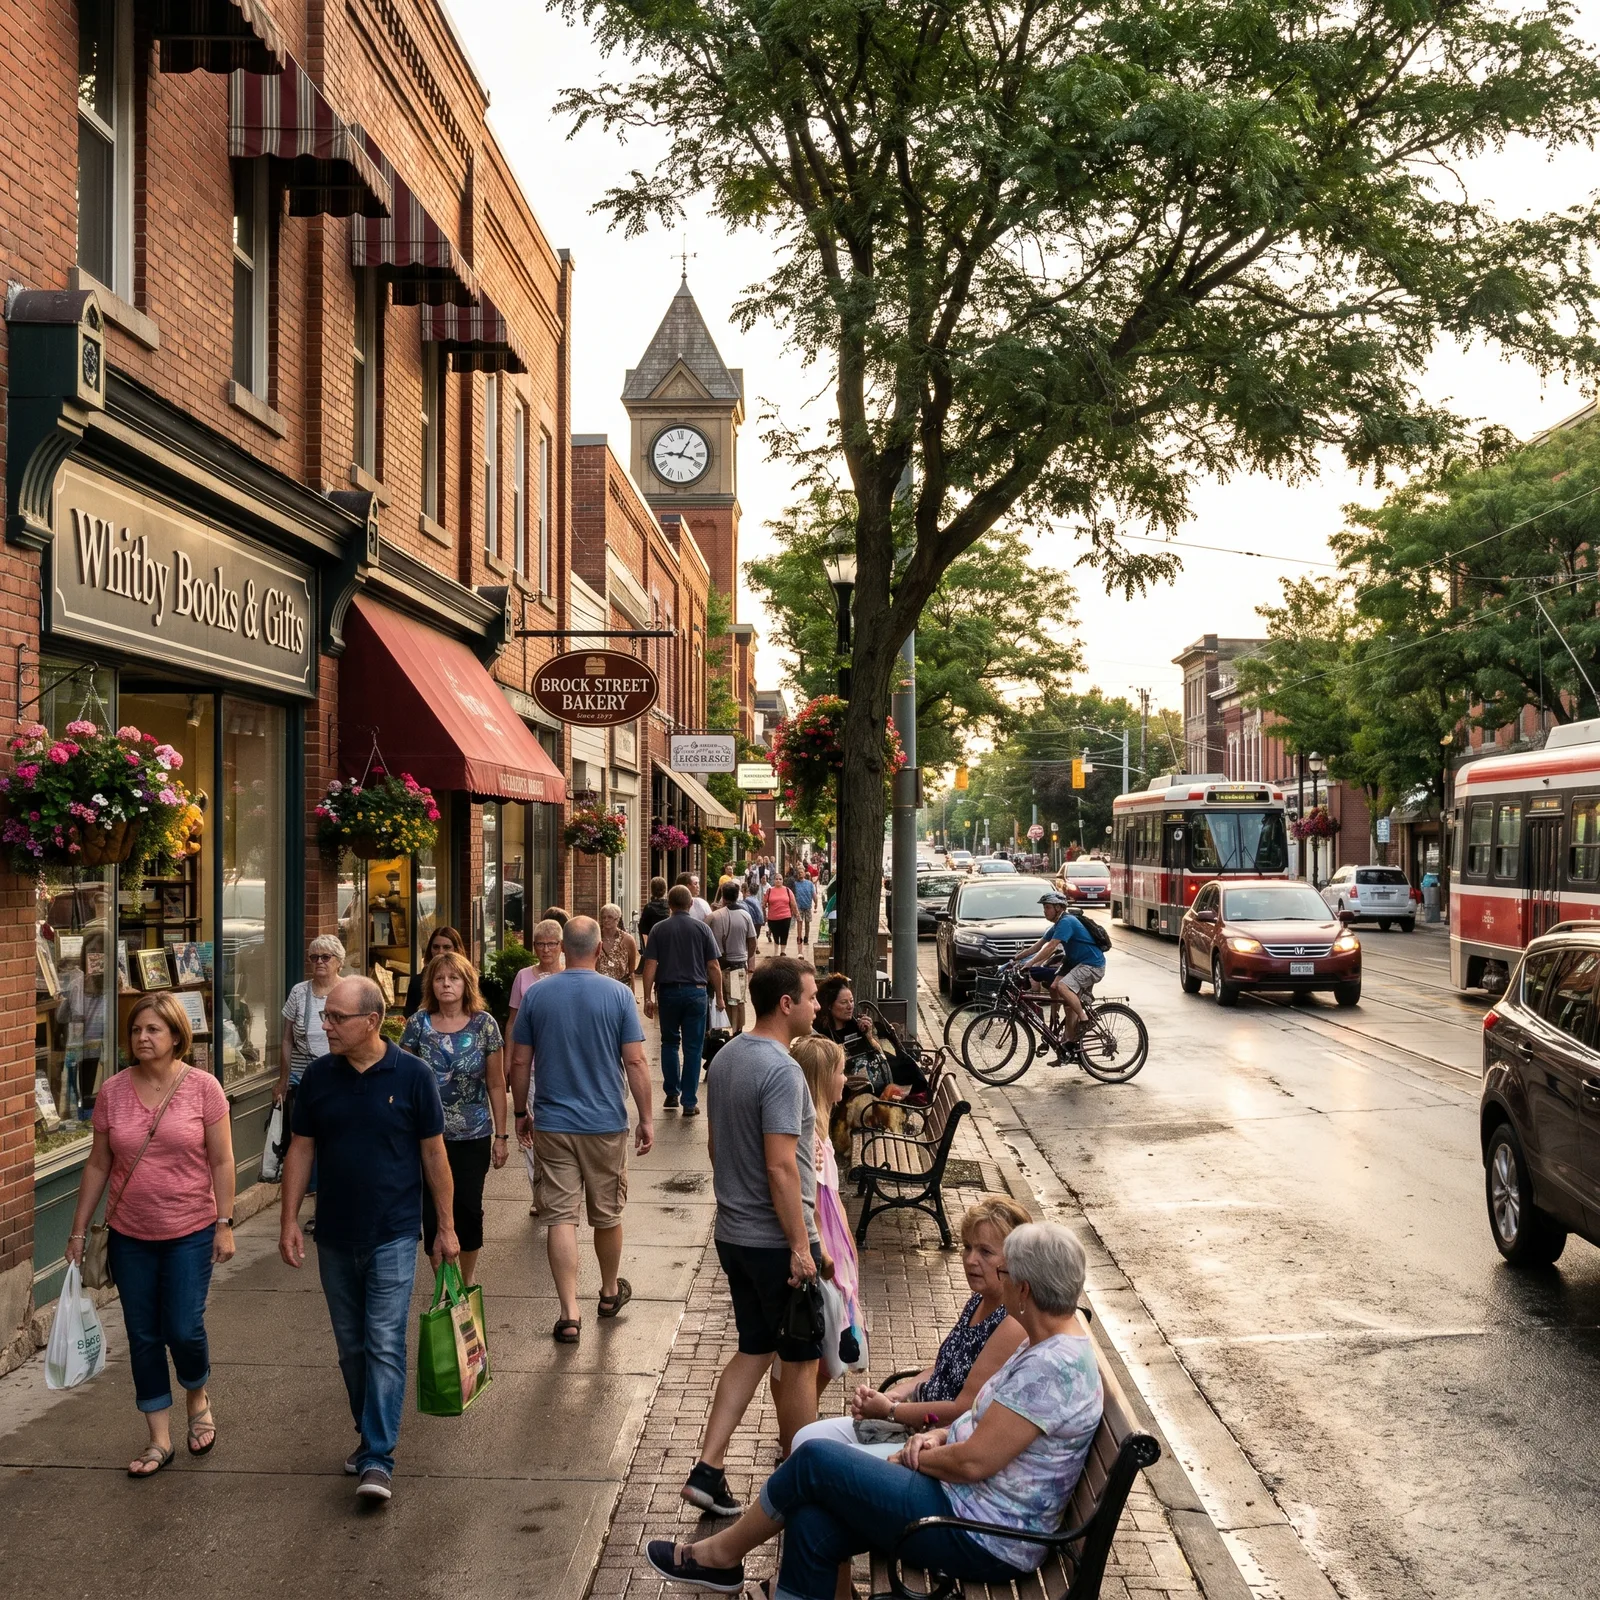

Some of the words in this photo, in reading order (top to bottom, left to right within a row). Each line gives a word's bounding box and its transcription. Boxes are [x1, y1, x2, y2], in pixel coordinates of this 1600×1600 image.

[71, 508, 170, 626] Whitby
[173, 550, 239, 633] Books
[243, 579, 260, 640] &
[264, 587, 304, 655] Gifts
[540, 677, 591, 692] BROCK
[594, 678, 650, 692] STREET
[562, 694, 629, 711] BAKERY
